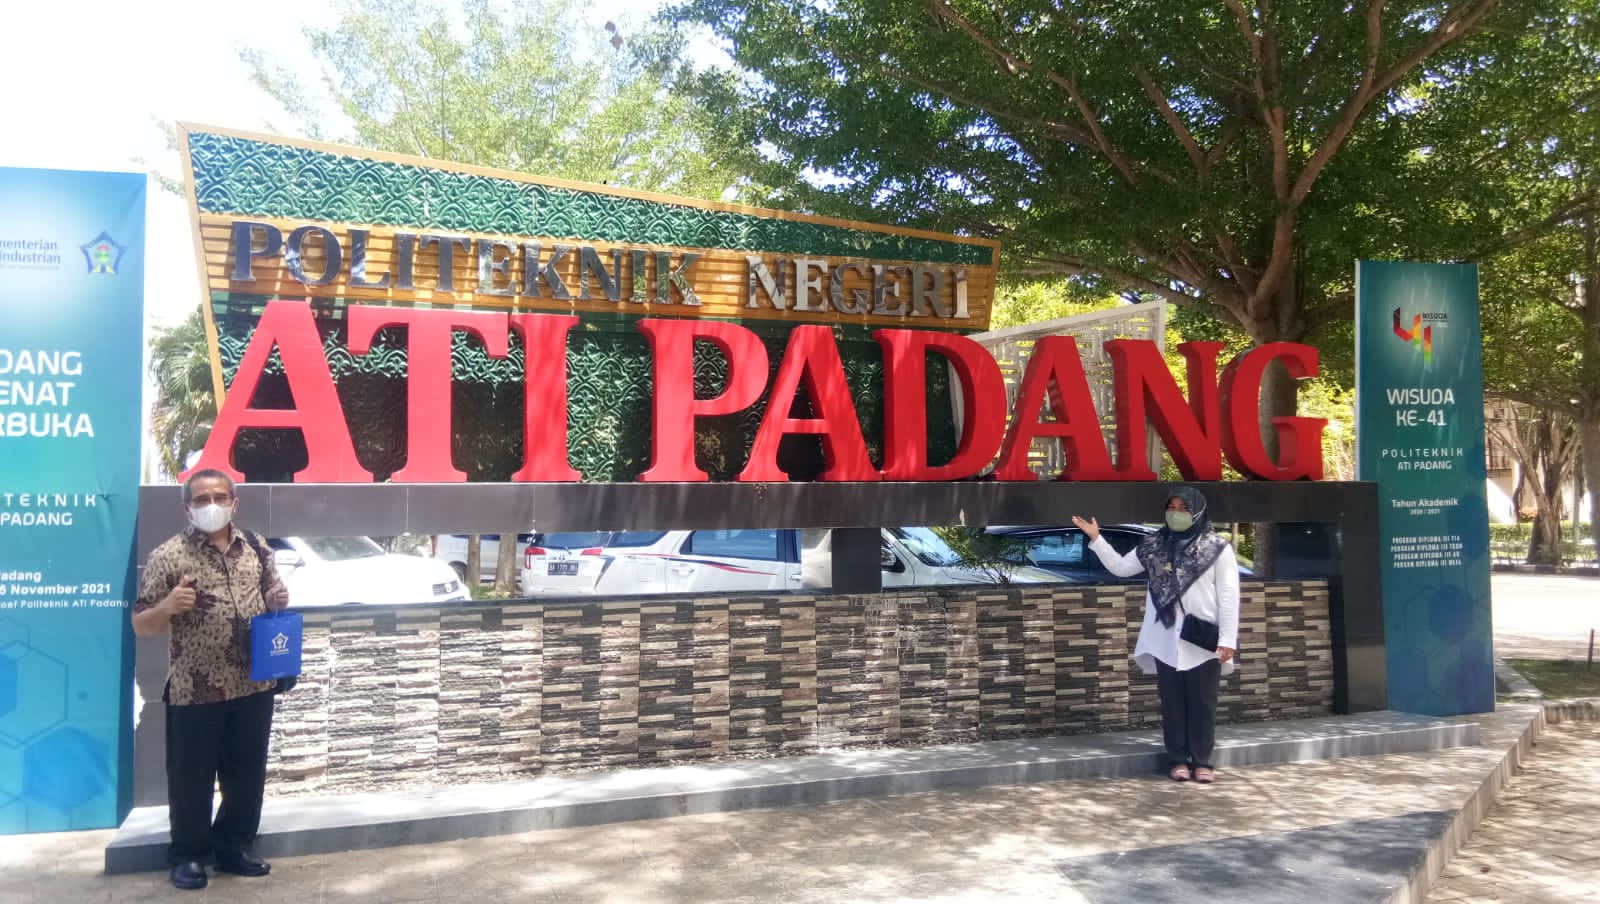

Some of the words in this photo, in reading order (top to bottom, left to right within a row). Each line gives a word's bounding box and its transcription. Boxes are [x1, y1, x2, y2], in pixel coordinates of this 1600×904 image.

[229, 220, 702, 306] POLITEKNIK
[745, 255, 972, 320] NEGERI
[179, 299, 581, 483] ATI
[636, 318, 1329, 483] PADANG
[1386, 388, 1456, 405] WISUDA
[1396, 409, 1448, 427] KE-41
[1381, 448, 1465, 459] POLITEKNIK
[1398, 462, 1411, 471] ATI
[1414, 461, 1453, 471] PADANG
[4, 493, 96, 507] TEKNIK
[1391, 499, 1417, 508] Tahun
[1418, 498, 1460, 507] Akademik
[0, 512, 73, 526] PADANG
[0, 571, 42, 583] adang
[11, 584, 78, 595] November
[81, 583, 111, 594] 2021
[20, 600, 69, 609] Politeknik
